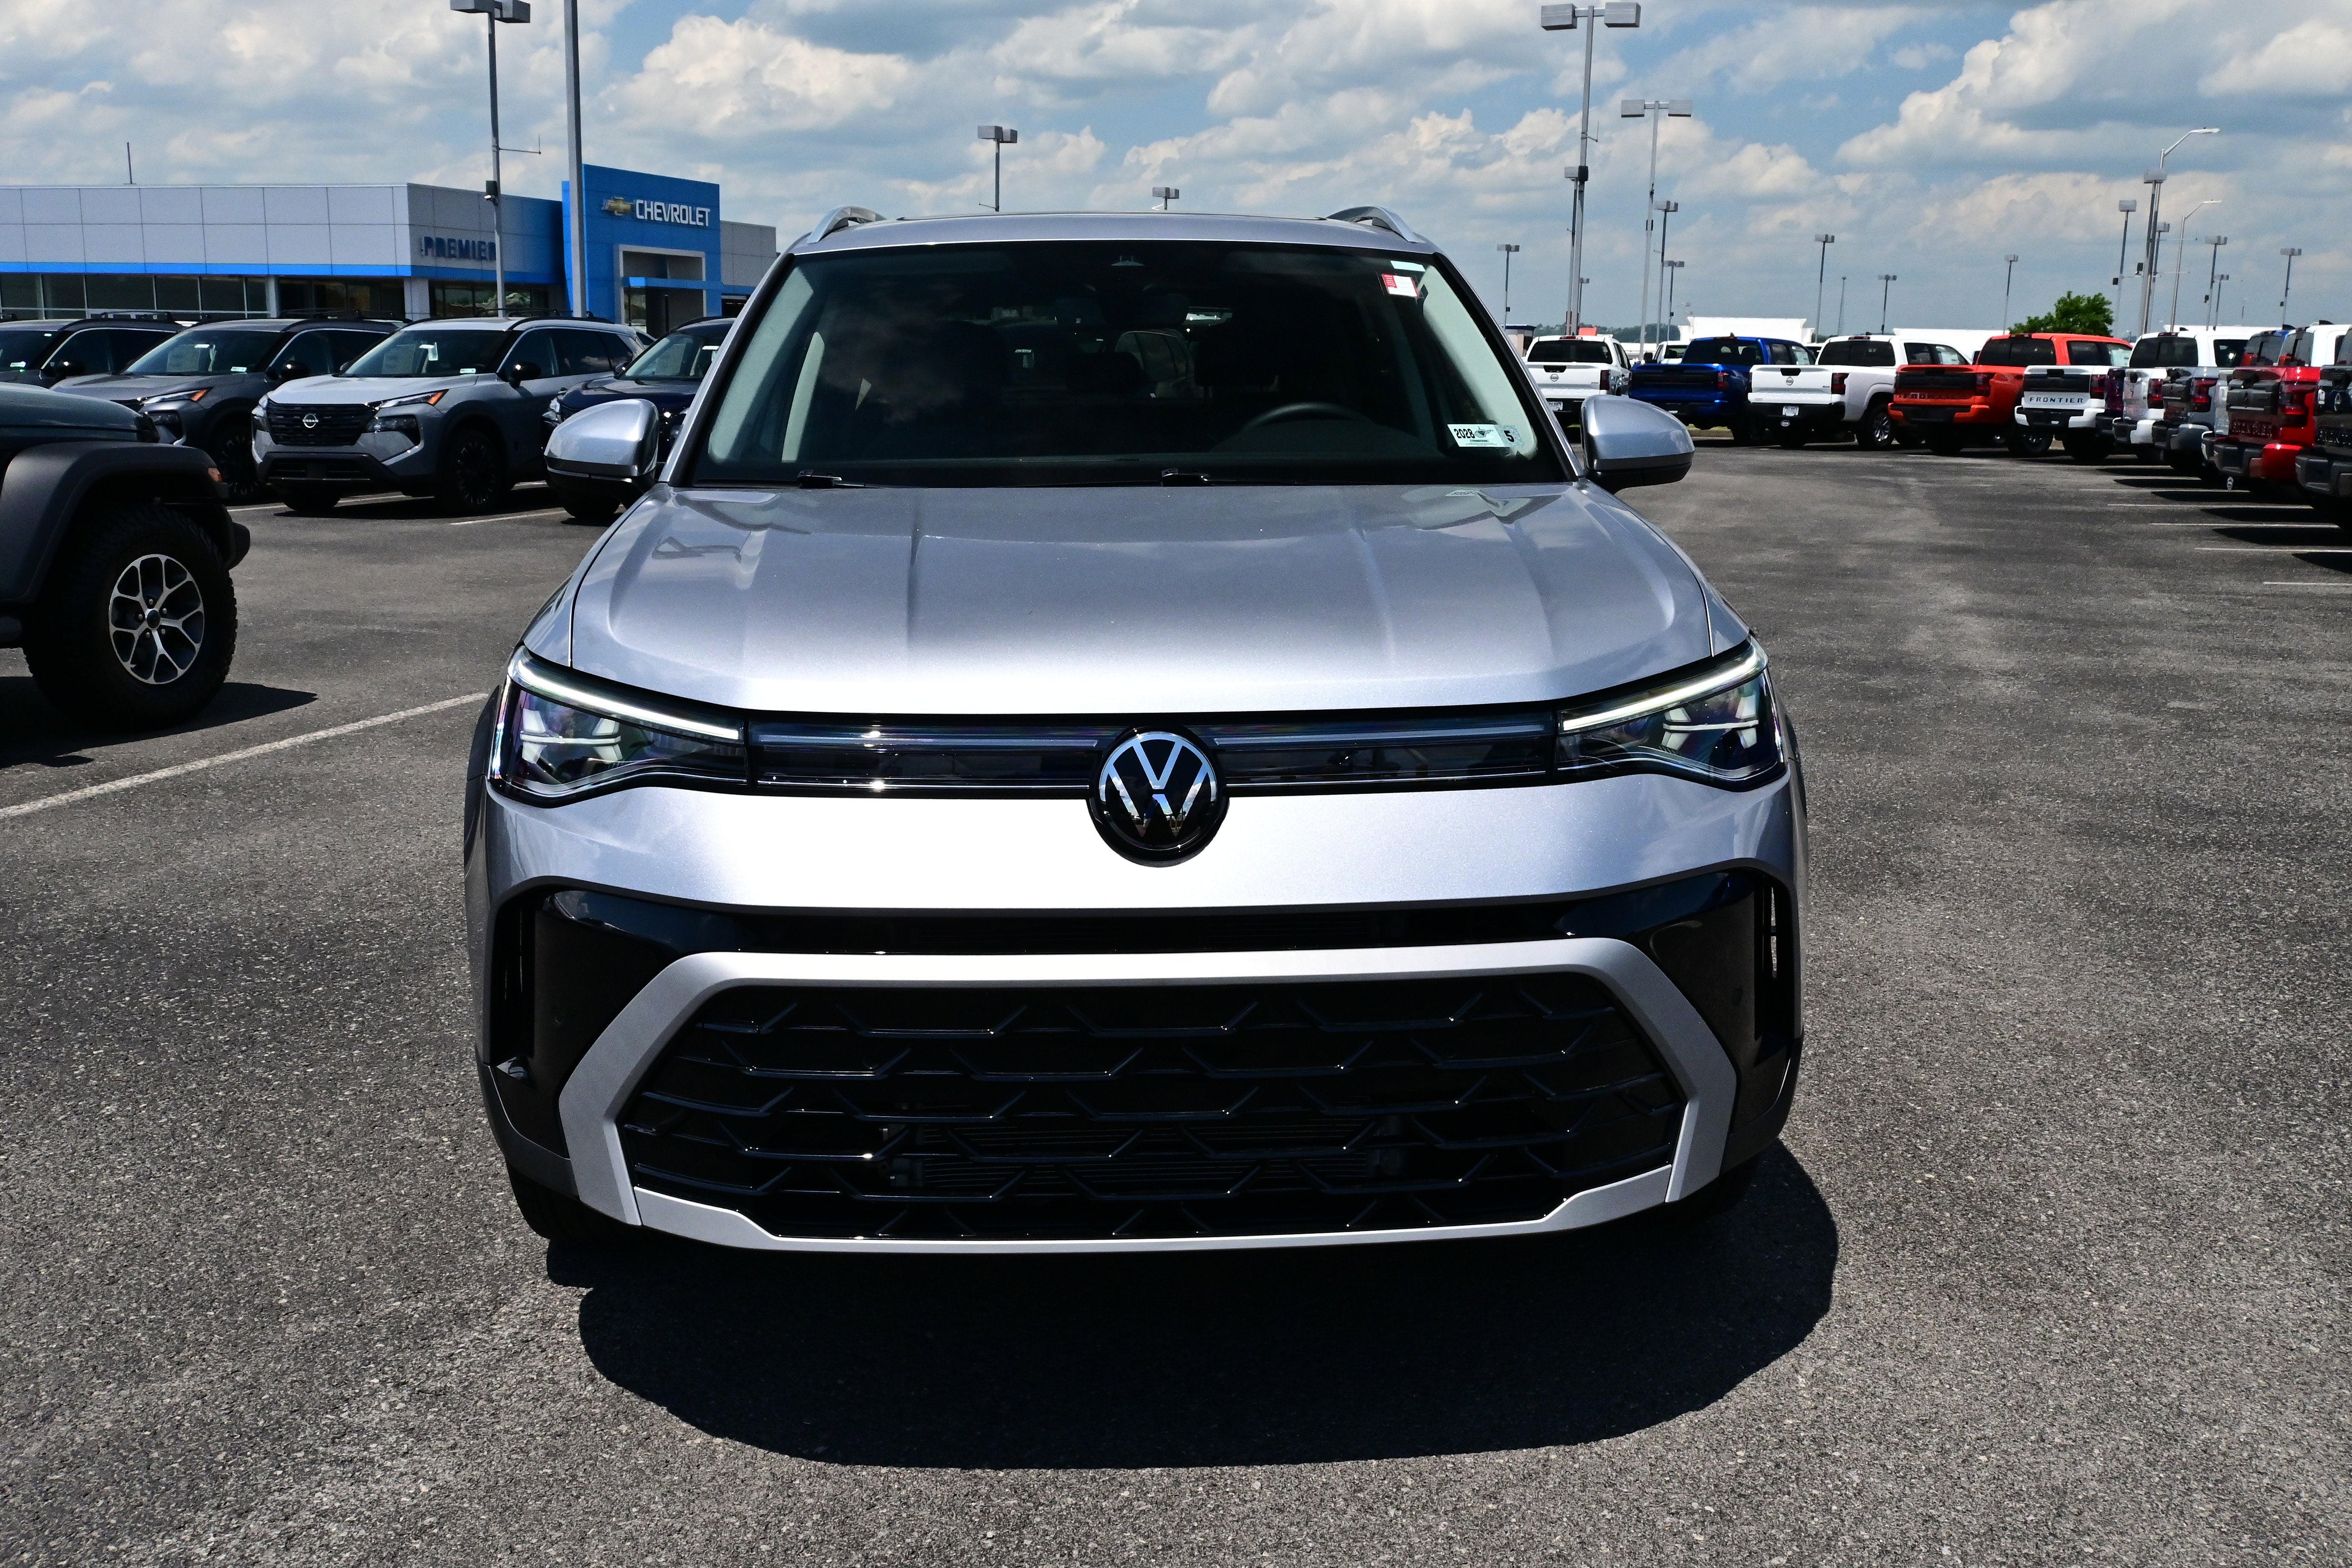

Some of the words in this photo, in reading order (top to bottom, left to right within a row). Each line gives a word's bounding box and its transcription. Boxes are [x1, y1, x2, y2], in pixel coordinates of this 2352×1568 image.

[636, 199, 710, 226] CHEVROLET
[424, 236, 496, 261] PREMIER
[1454, 428, 1475, 438] 2028
[1503, 430, 1515, 442] 5
